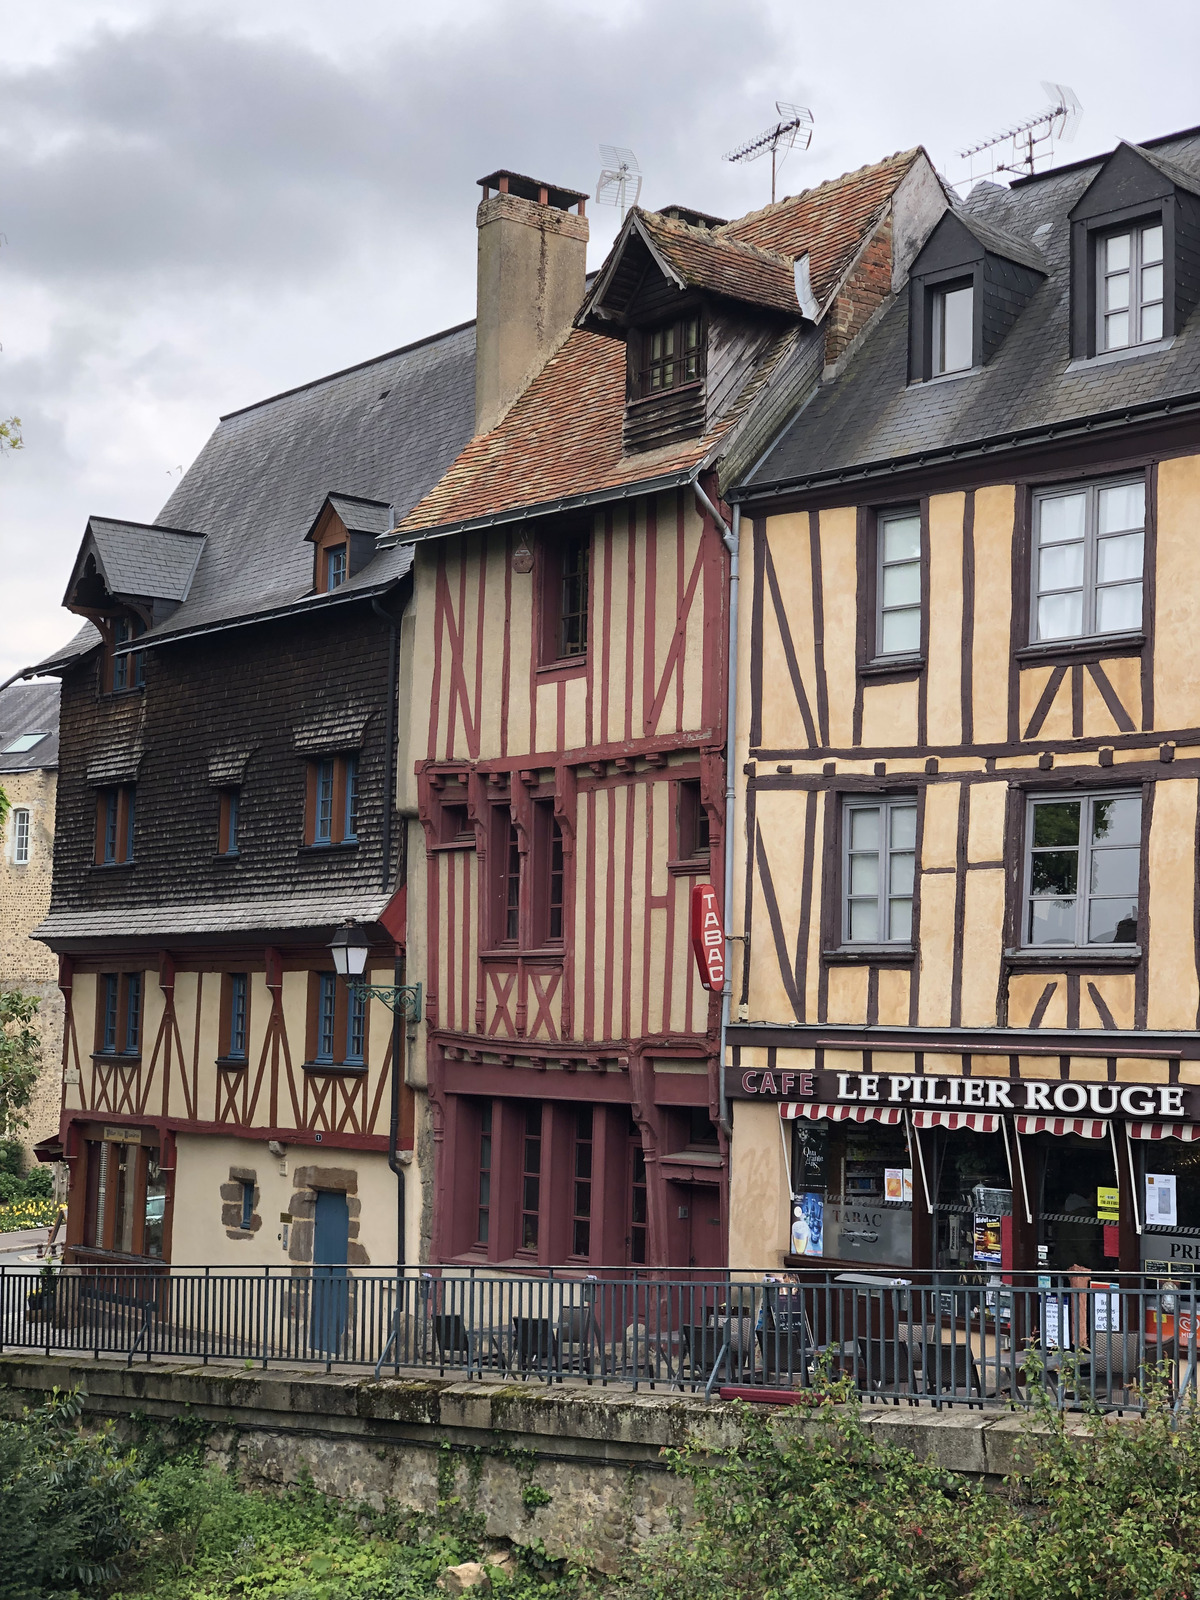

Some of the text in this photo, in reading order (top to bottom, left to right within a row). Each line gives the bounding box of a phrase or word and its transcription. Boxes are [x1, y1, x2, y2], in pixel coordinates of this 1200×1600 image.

[703, 893, 724, 982] TABAC
[740, 1070, 814, 1097] CAFE
[837, 1073, 1185, 1116] LE PILIER ROUGE
[832, 1209, 882, 1227] TABAC
